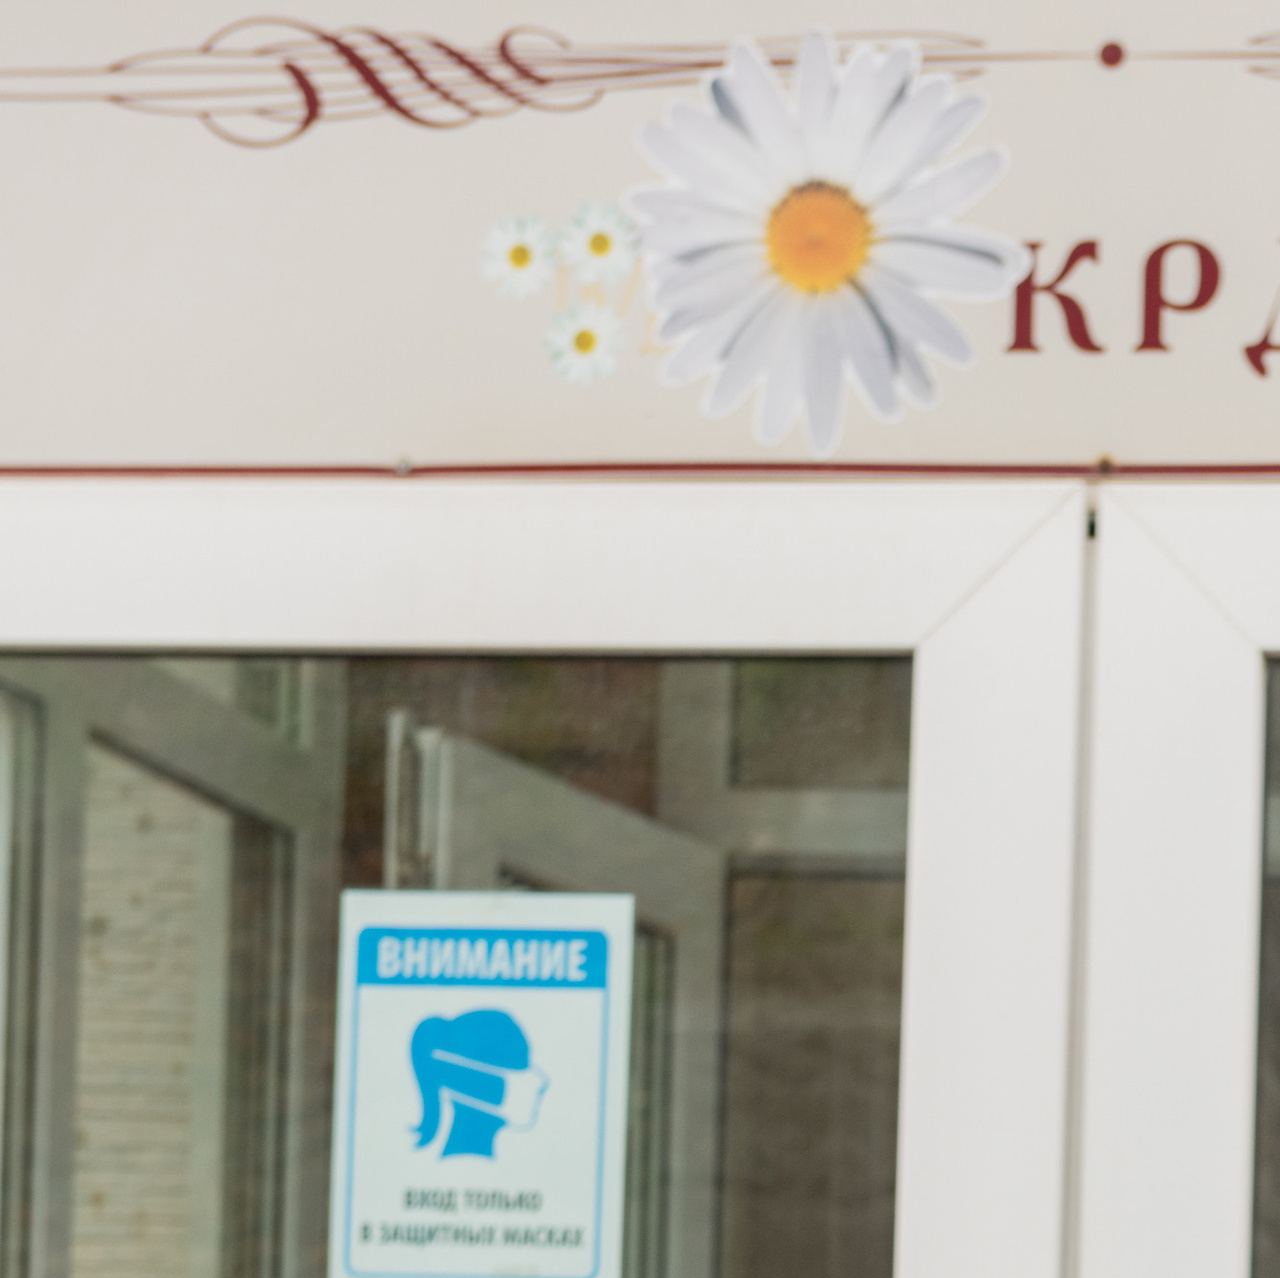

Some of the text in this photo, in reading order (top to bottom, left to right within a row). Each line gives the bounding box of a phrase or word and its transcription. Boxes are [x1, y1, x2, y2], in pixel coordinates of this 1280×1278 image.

[376, 935, 589, 982] ВНИМАНИЕ
[402, 1187, 544, 1215] ВХОД ТОЛЬКО
[359, 1221, 585, 1248] В ЗАЩИТНЫХ МАСКАХ
